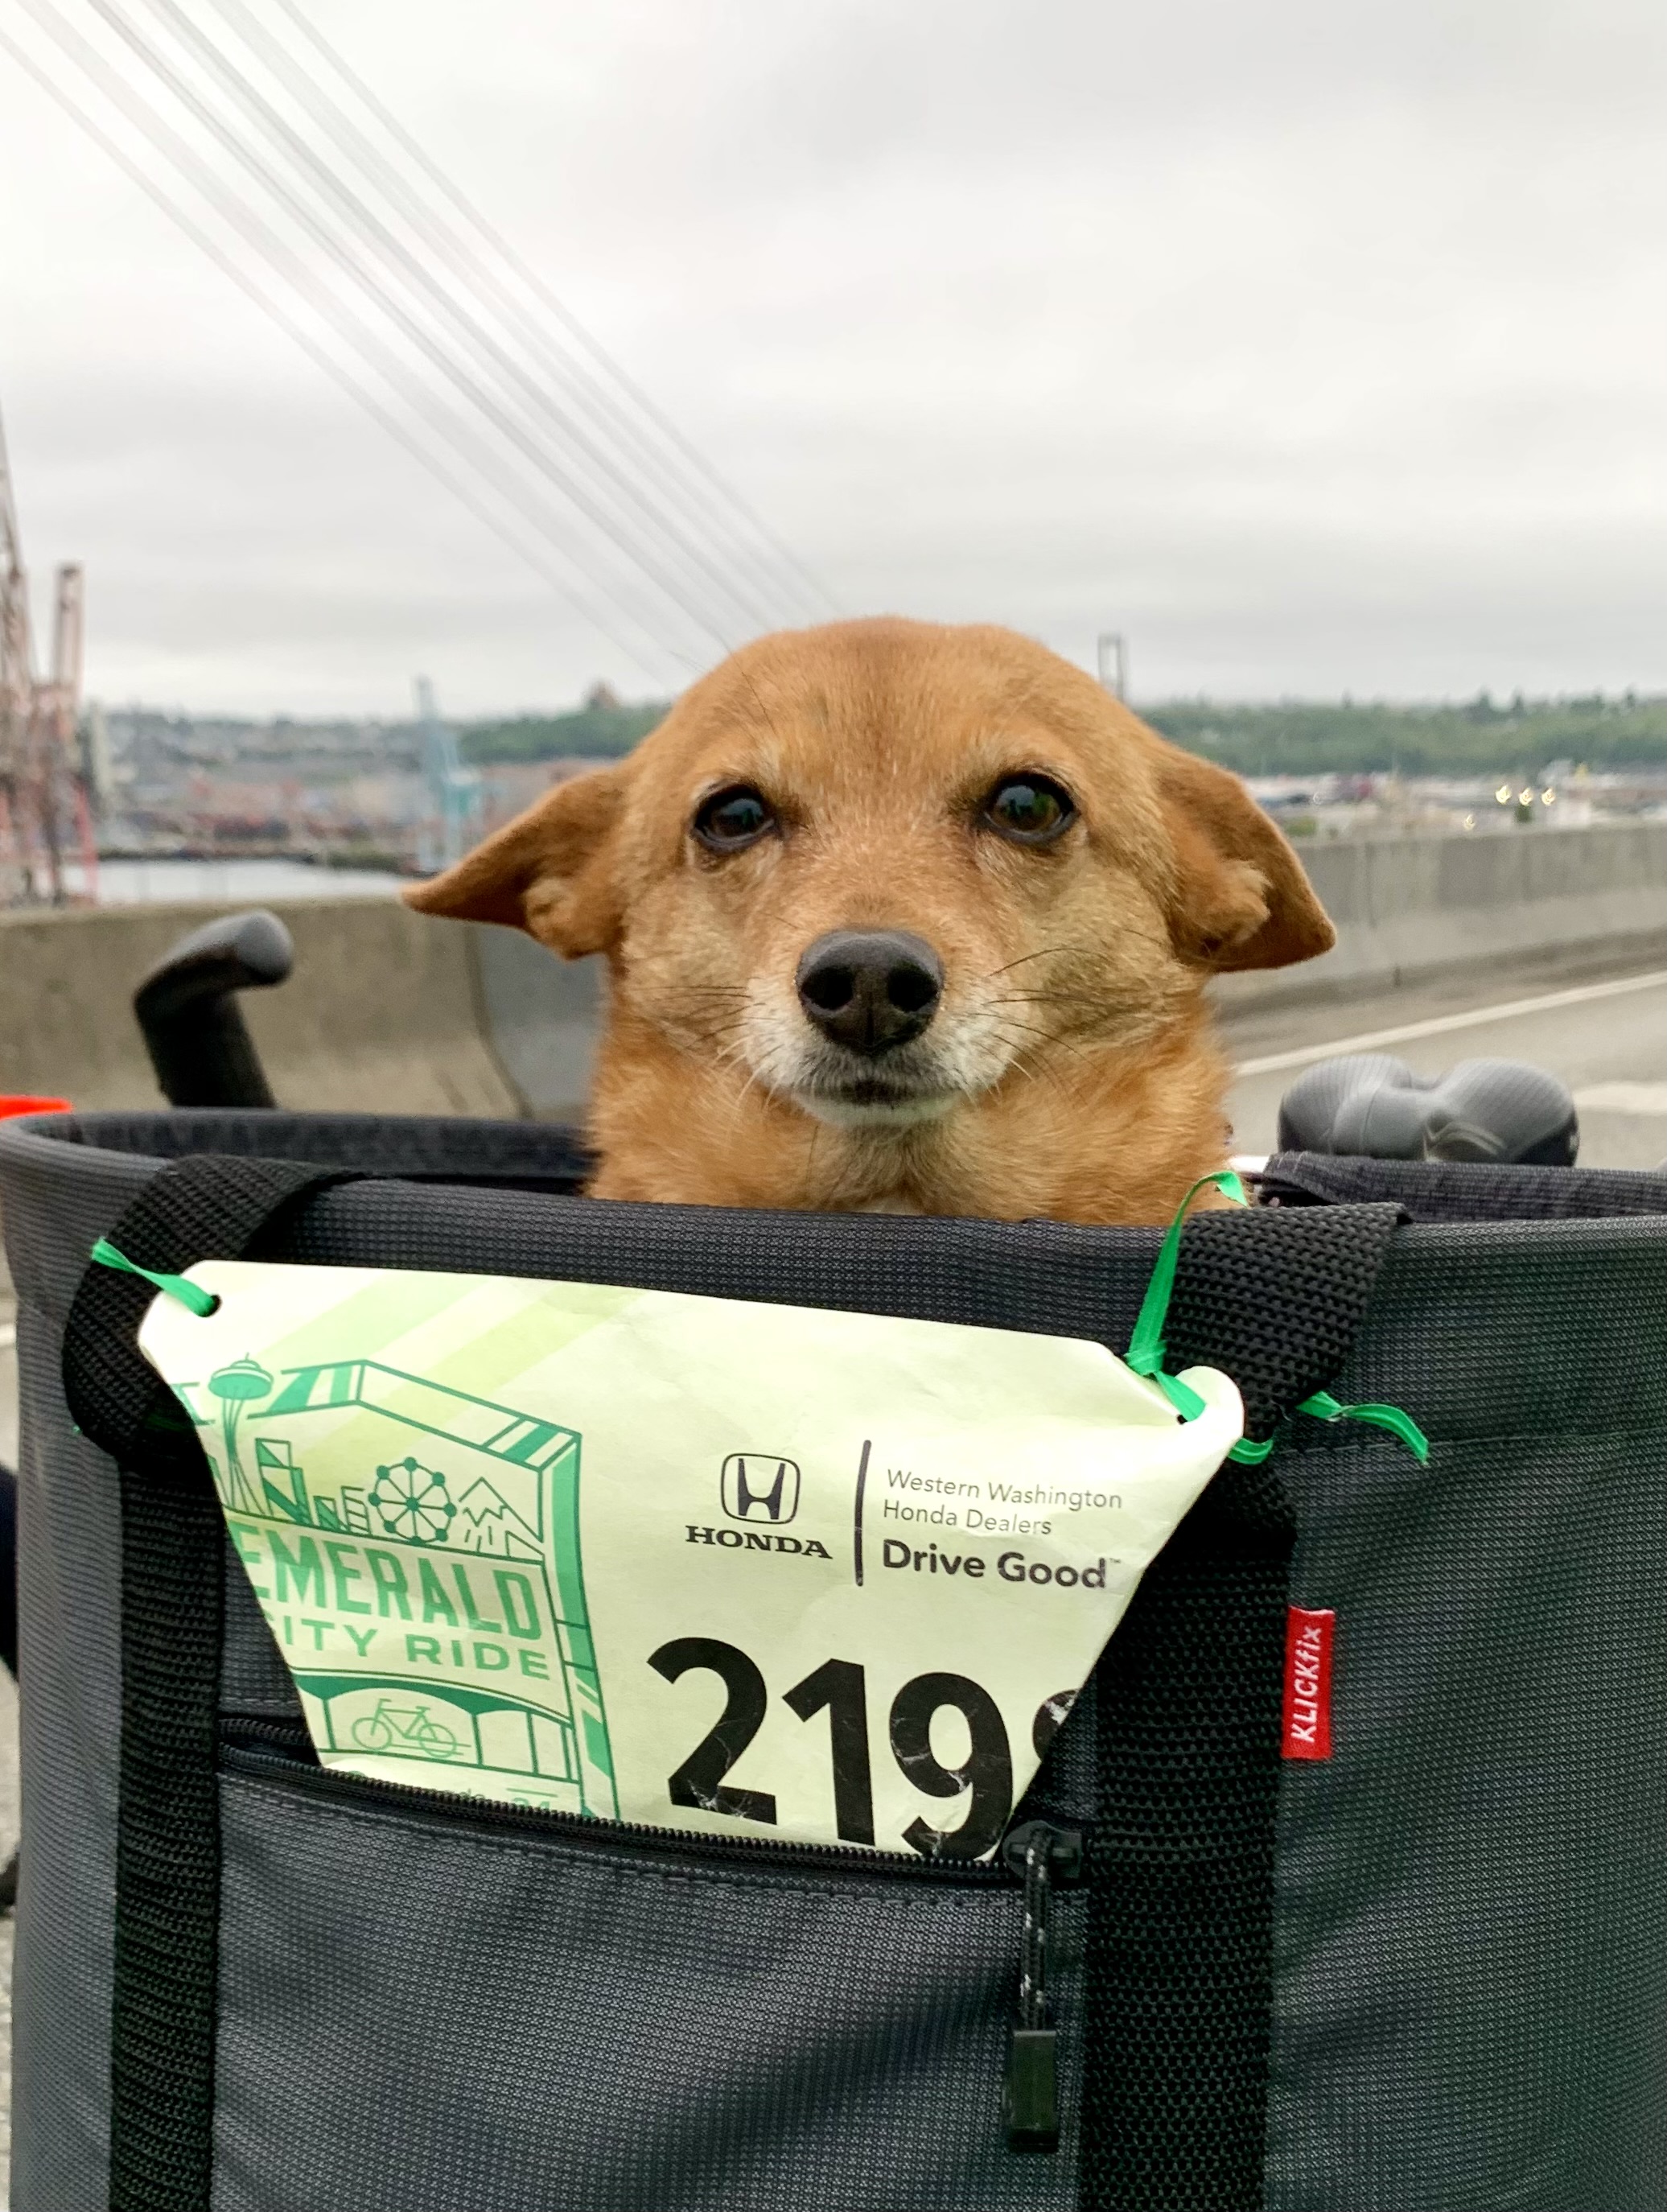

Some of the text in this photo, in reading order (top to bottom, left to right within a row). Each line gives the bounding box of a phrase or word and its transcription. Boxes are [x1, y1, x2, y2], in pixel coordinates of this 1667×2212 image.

[883, 1498, 1052, 1535] Honda Dealers
[887, 1468, 1123, 1512] Western Washington
[685, 1525, 834, 1559] HONDA
[883, 1538, 986, 1579] Drive
[228, 1519, 542, 1641] EMERALD
[264, 1610, 550, 1681] ITY RIDE
[1290, 1625, 1322, 1744] KLICKfix
[646, 1637, 1080, 1862] 219
